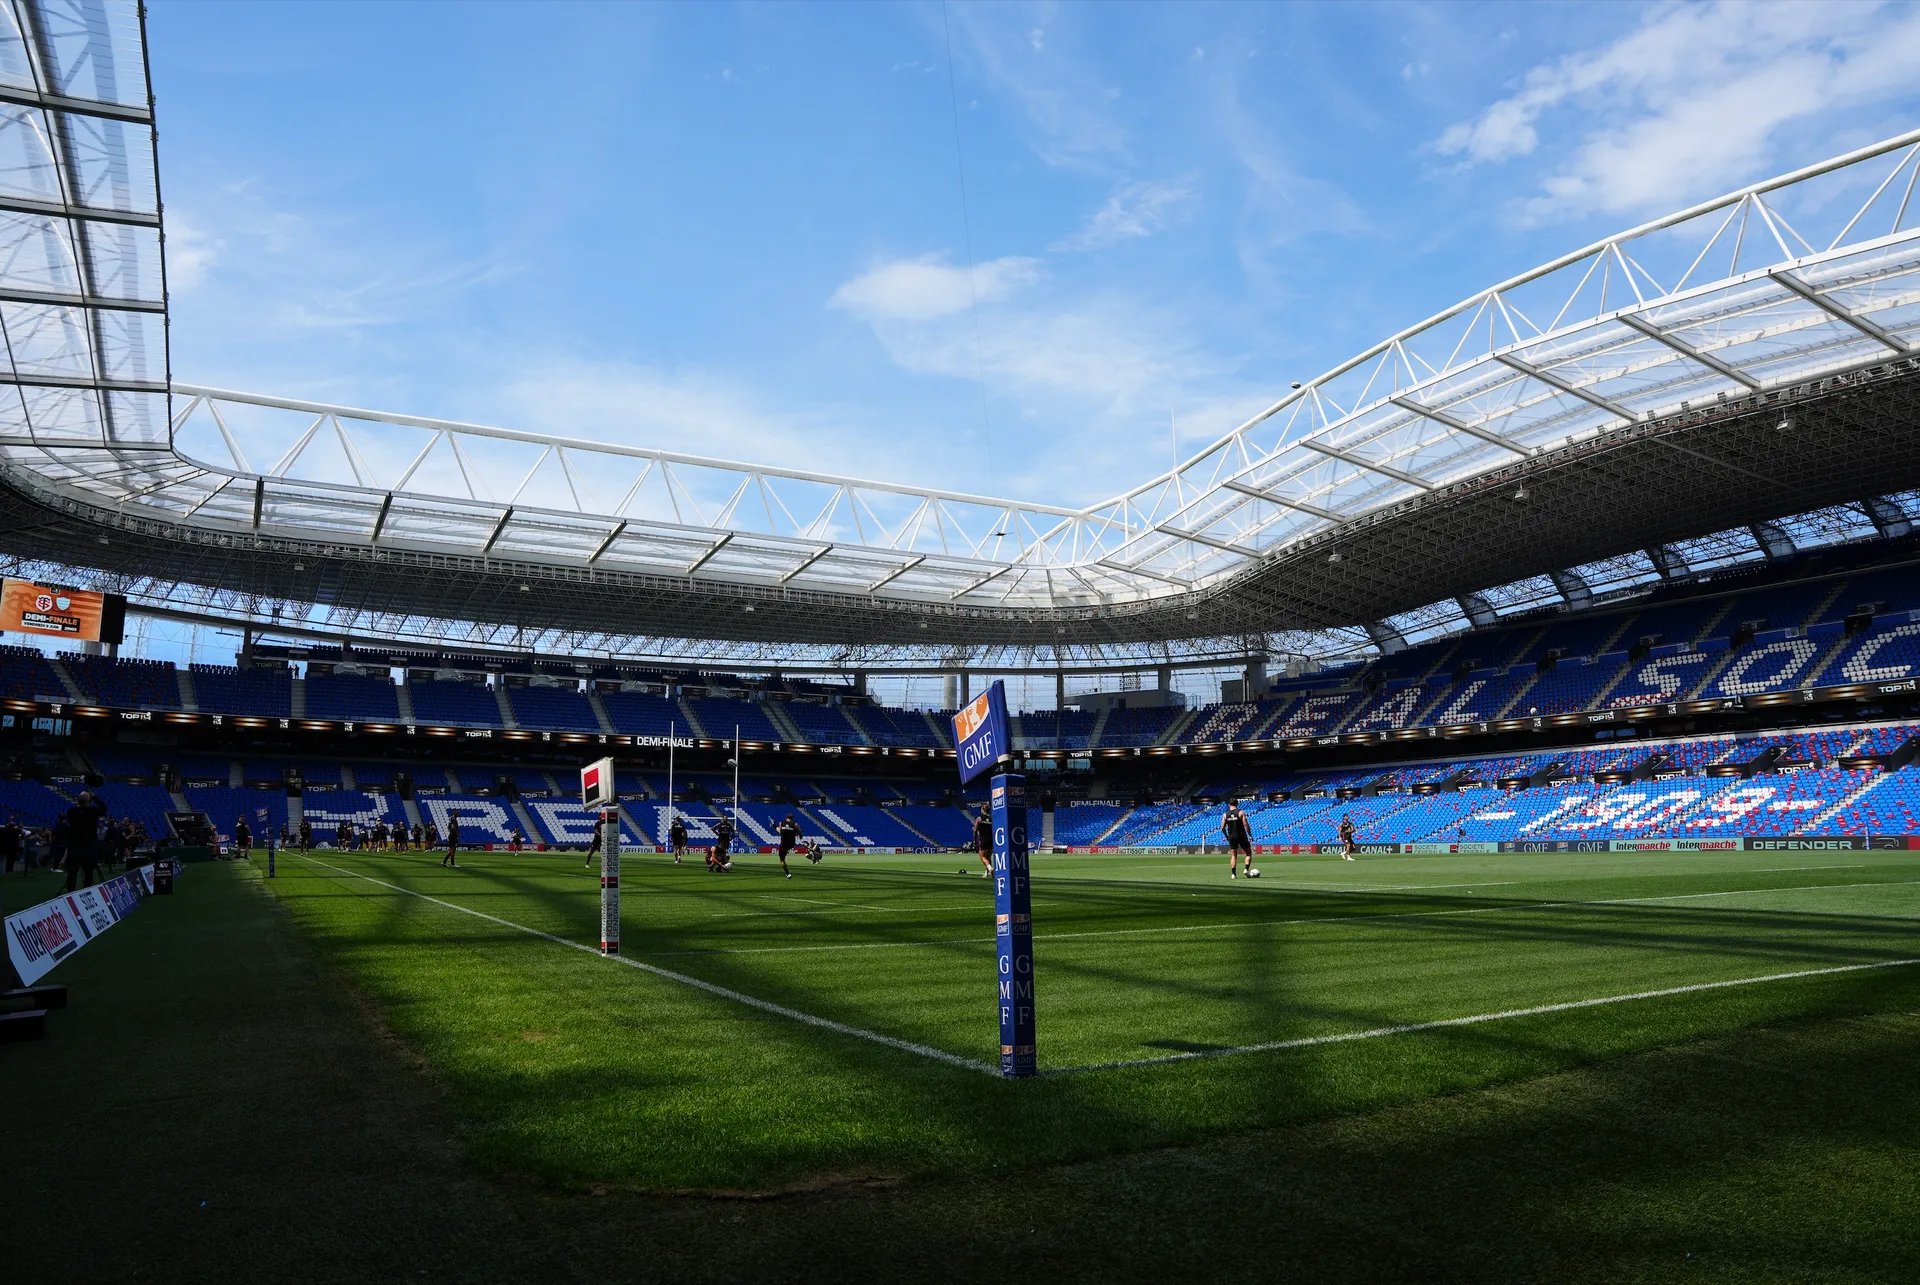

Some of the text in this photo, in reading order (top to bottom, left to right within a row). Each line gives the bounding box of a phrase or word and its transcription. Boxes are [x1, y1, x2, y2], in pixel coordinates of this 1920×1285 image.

[25, 613, 78, 625] DEMI-FINALE
[1879, 680, 1917, 693] TOP14
[120, 711, 152, 720] TOP14
[1191, 680, 1487, 742] REAL
[1588, 711, 1615, 722] TOP14
[465, 729, 492, 739] TOP14
[637, 736, 694, 748] DEMI-FINALE
[1318, 736, 1339, 745] TOP14
[820, 745, 841, 754] TOP14
[964, 731, 992, 769] GMF
[417, 788, 446, 796] TOP14
[520, 791, 547, 799] TOP14
[618, 793, 644, 801] TOP14
[993, 798, 1004, 806] GMF
[1321, 846, 1346, 854] CANAL
[1360, 845, 1393, 854] CANAL+
[1523, 842, 1549, 852] GMF
[1577, 842, 1604, 852] GMF
[1616, 840, 1737, 851] Intermarché Intermarché
[1752, 840, 1853, 850] DEFENDER
[995, 827, 1006, 896] GMF
[1011, 826, 1027, 895] GMF
[997, 925, 1008, 933] GMF
[1014, 924, 1028, 932] GMF
[9, 906, 72, 963] Intermarché
[1000, 955, 1011, 1025] GMF
[1015, 954, 1032, 1026] GMF
[1017, 1055, 1032, 1063] GMF
